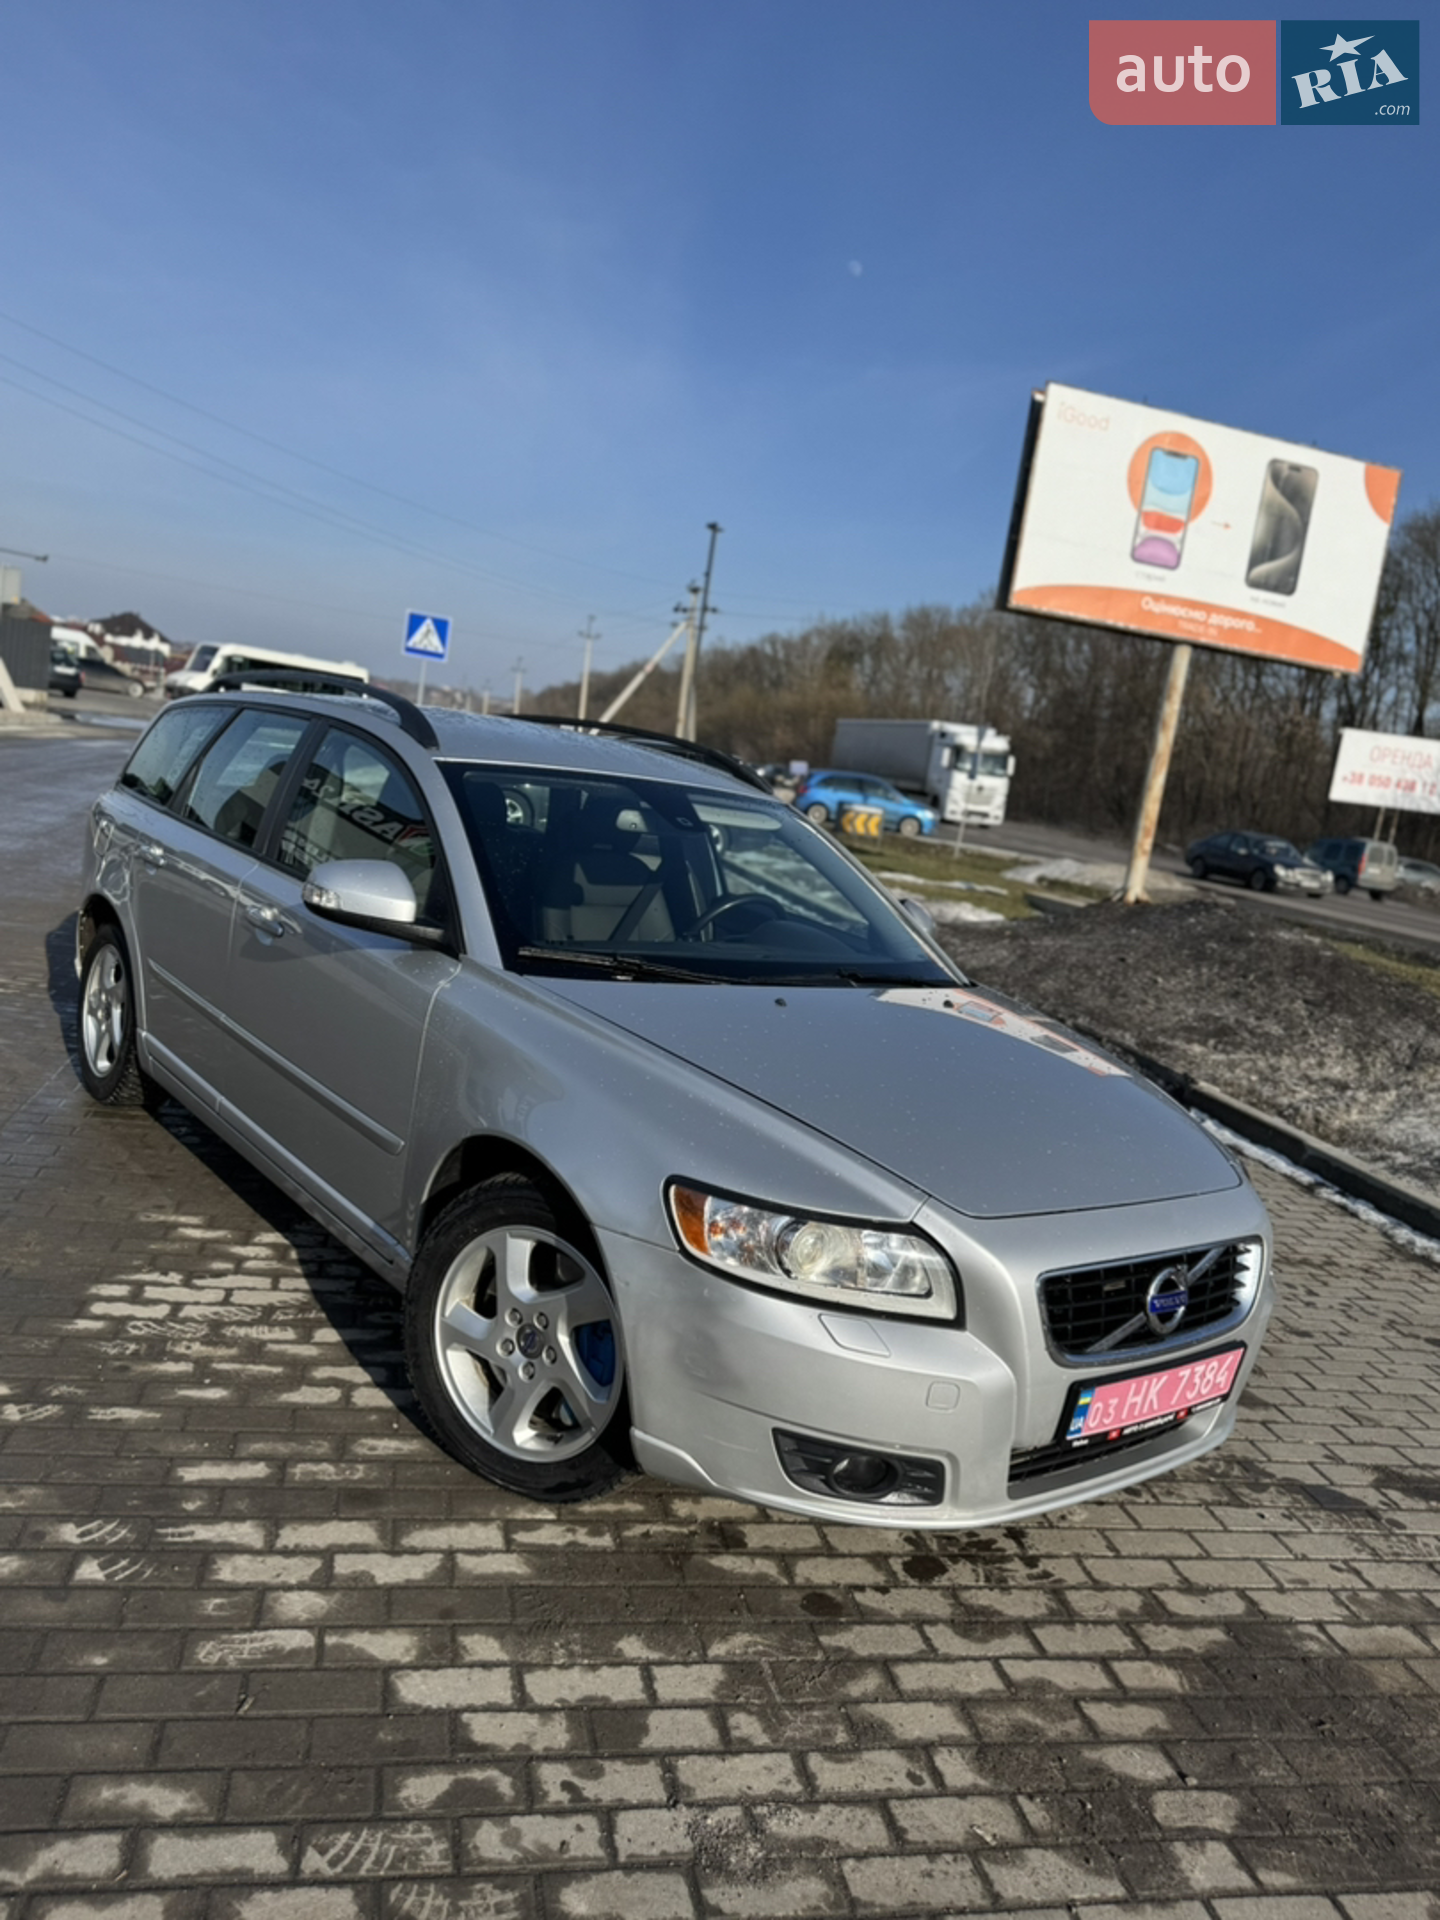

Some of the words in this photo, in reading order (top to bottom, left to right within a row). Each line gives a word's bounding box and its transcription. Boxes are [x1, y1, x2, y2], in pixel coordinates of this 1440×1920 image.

[1056, 401, 1111, 432] iGood
[1087, 1397, 1119, 1429] 03
[1121, 1374, 1169, 1420] HK
[1169, 1354, 1235, 1406] 7384
